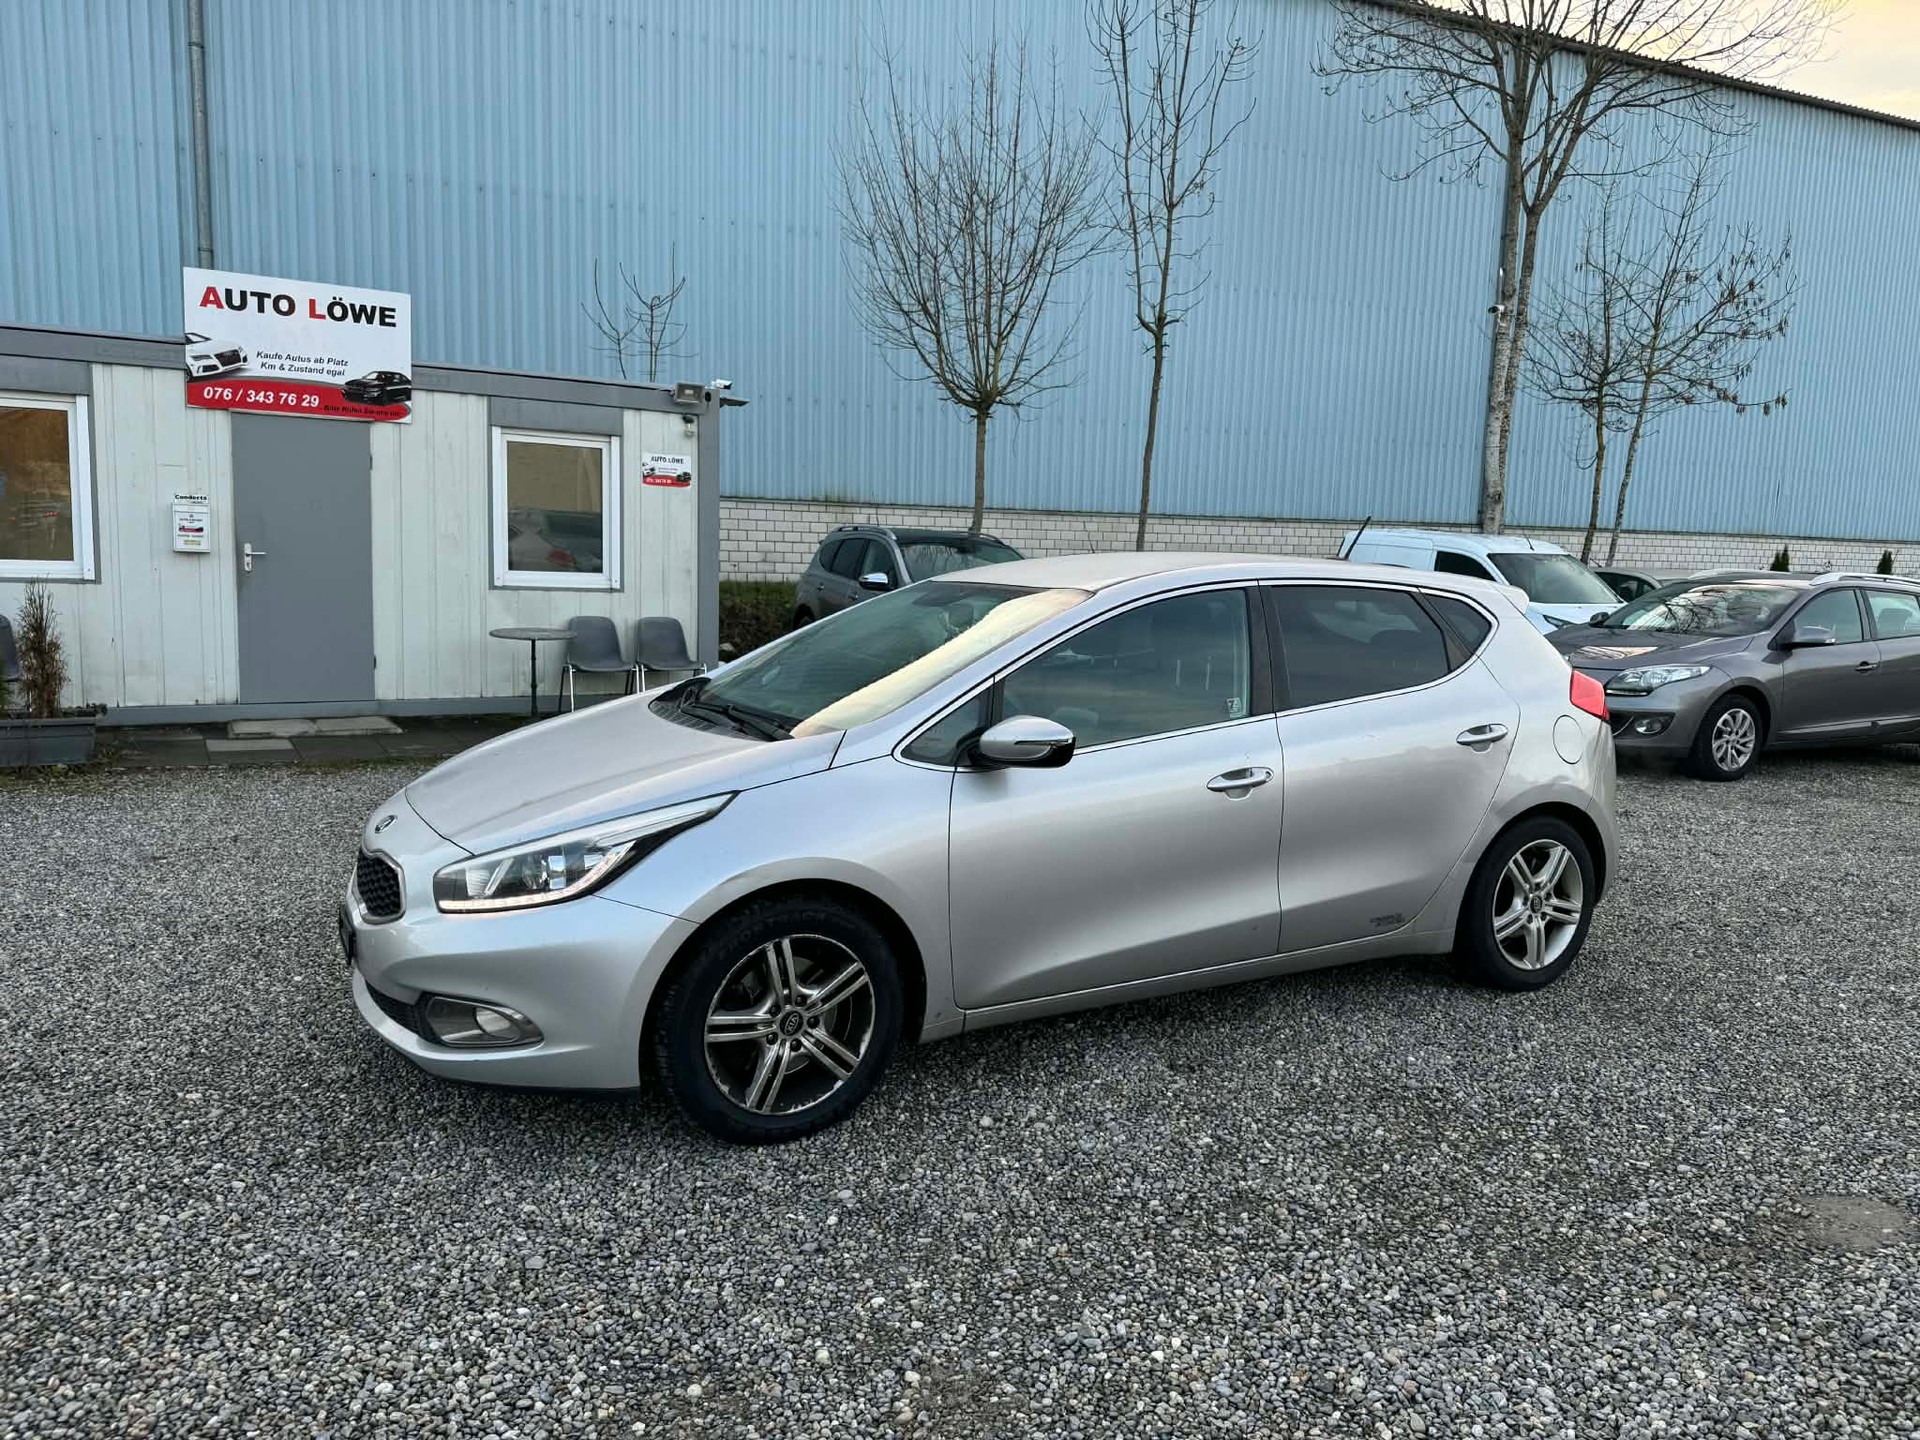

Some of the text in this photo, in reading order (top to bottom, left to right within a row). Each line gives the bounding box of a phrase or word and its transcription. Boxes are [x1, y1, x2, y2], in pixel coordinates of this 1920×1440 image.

[199, 286, 397, 328] AUTO LÖWE
[256, 351, 283, 360] Kaufe
[326, 357, 349, 367] Platz
[260, 361, 345, 377] Km & Zustand egal
[203, 386, 320, 408] 076 / 343 76 29
